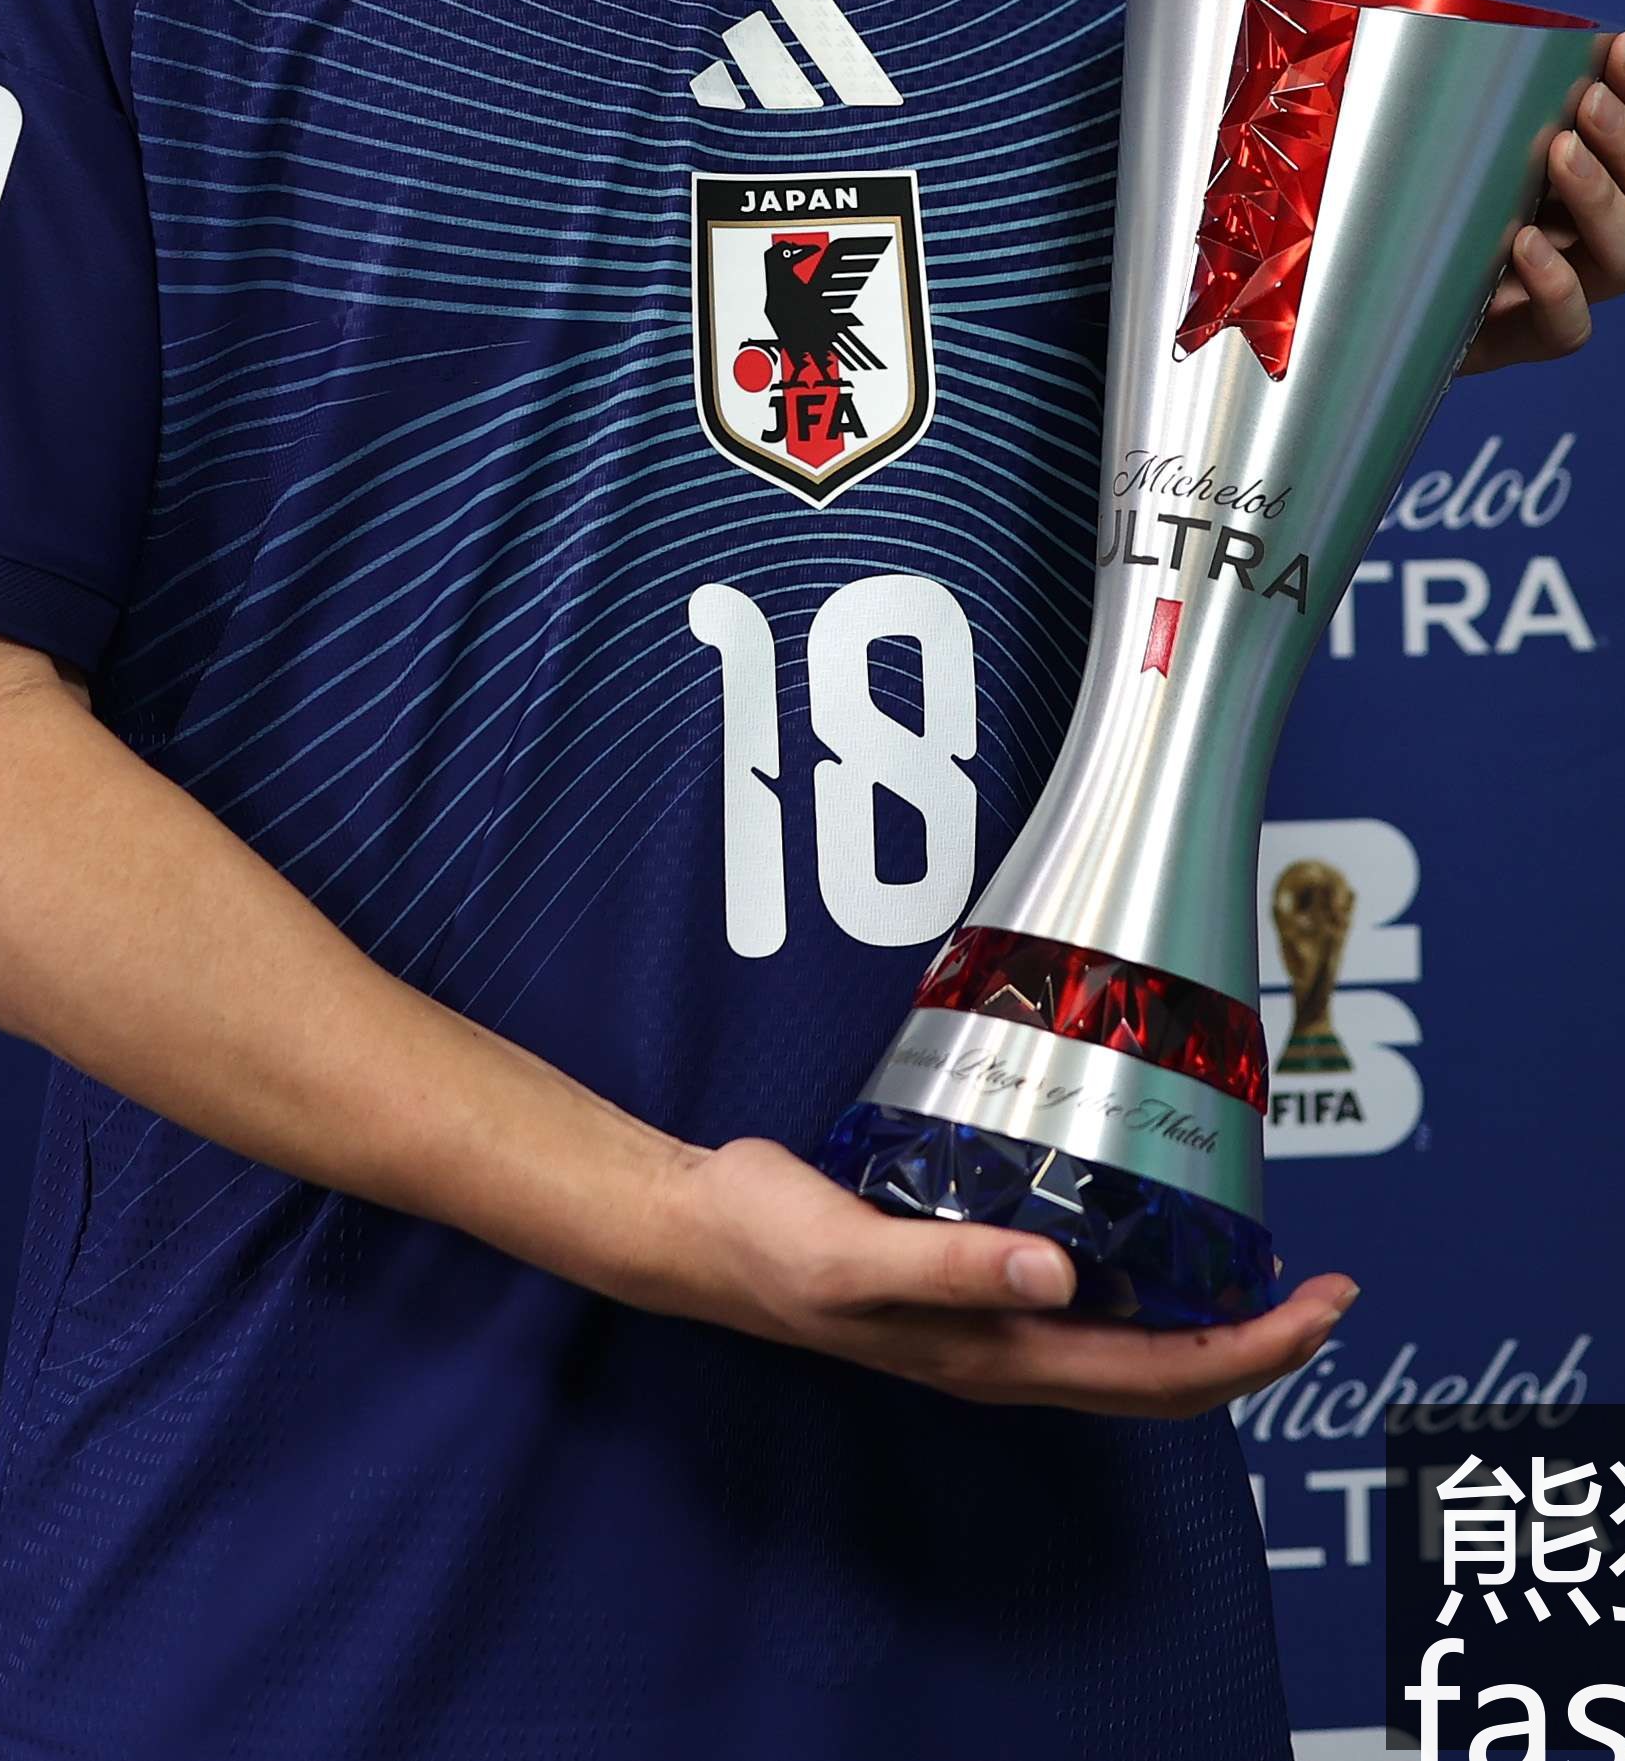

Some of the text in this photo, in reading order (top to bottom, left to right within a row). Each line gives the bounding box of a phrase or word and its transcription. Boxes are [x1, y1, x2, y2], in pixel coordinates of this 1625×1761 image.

[740, 187, 859, 214] JAPAN
[762, 393, 867, 443] JFA
[1113, 450, 1292, 519] Michelob
[1376, 433, 1574, 532] elob
[1331, 557, 1595, 657] TRA
[688, 574, 977, 958] 18
[1272, 1092, 1362, 1125] FIFA
